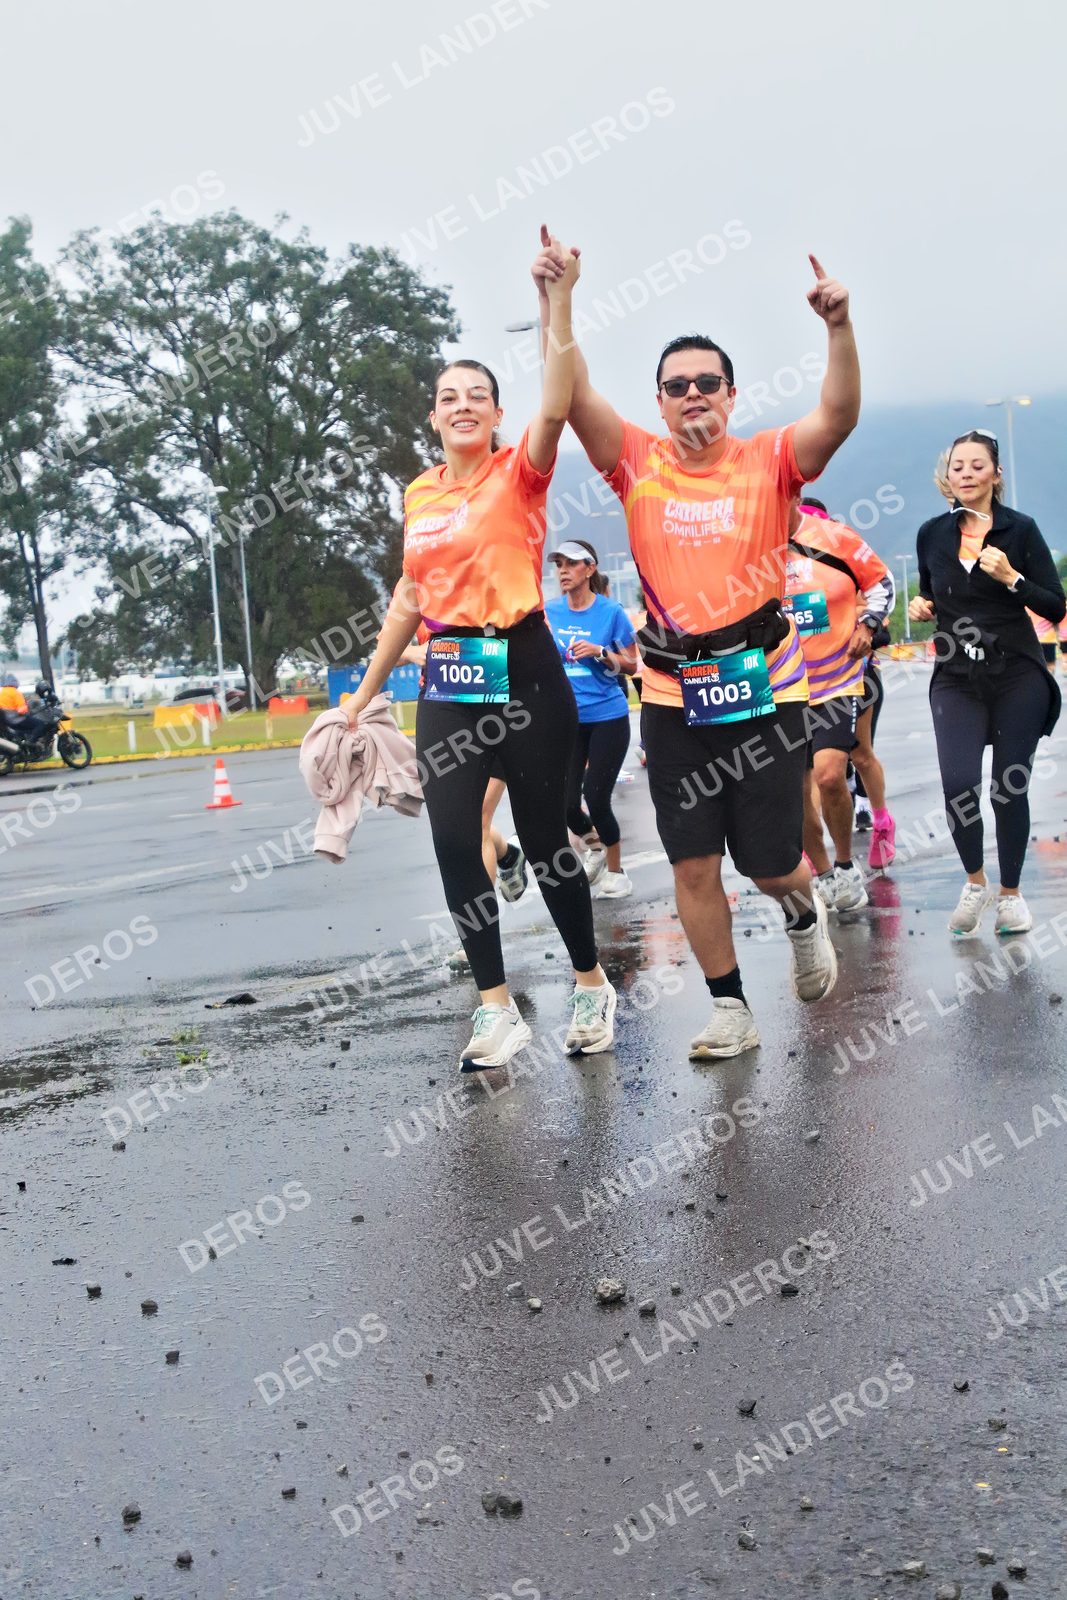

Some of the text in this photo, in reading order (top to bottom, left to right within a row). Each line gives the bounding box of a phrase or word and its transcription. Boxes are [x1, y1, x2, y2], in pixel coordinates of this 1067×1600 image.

[664, 496, 735, 521] CARRERA
[662, 520, 719, 537] OMNILIFE
[431, 641, 460, 653] CARRERA
[482, 643, 500, 656] 10K
[742, 654, 759, 670] 10K
[439, 664, 485, 684] 1002
[682, 664, 719, 678] CARRERA
[683, 675, 711, 685] OMNILIFE
[697, 680, 752, 707] 1003
